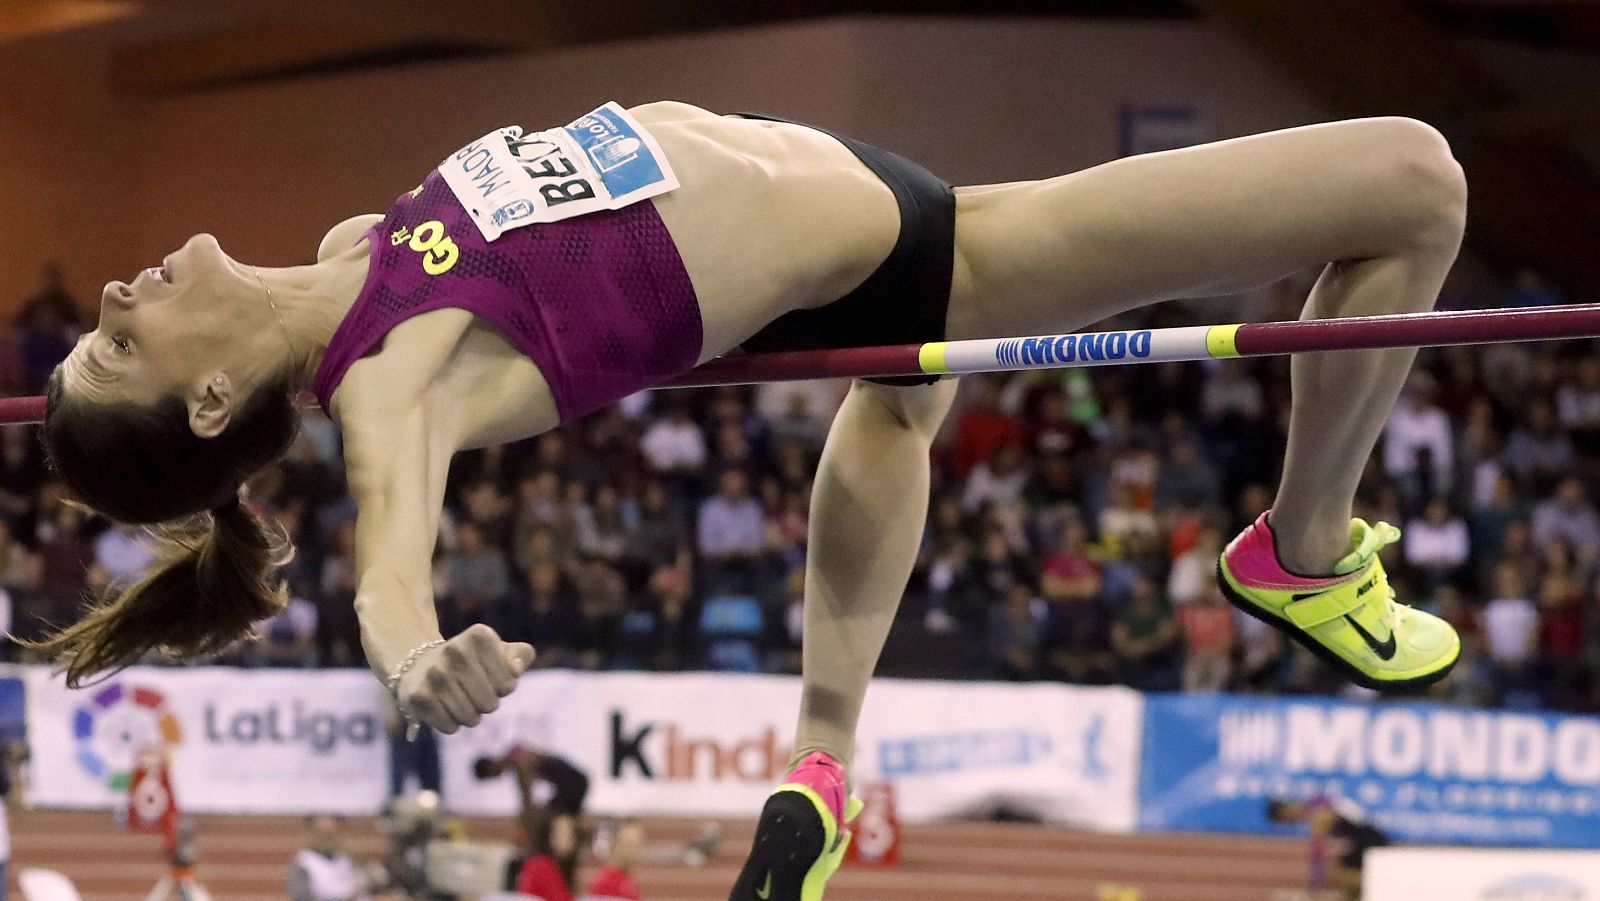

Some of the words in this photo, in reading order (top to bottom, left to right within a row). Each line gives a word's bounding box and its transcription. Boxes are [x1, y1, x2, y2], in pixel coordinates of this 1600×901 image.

[409, 220, 460, 275] GO
[1021, 331, 1152, 365] MONDO
[204, 698, 376, 754] LaLiga
[1284, 702, 1600, 785] MONDO
